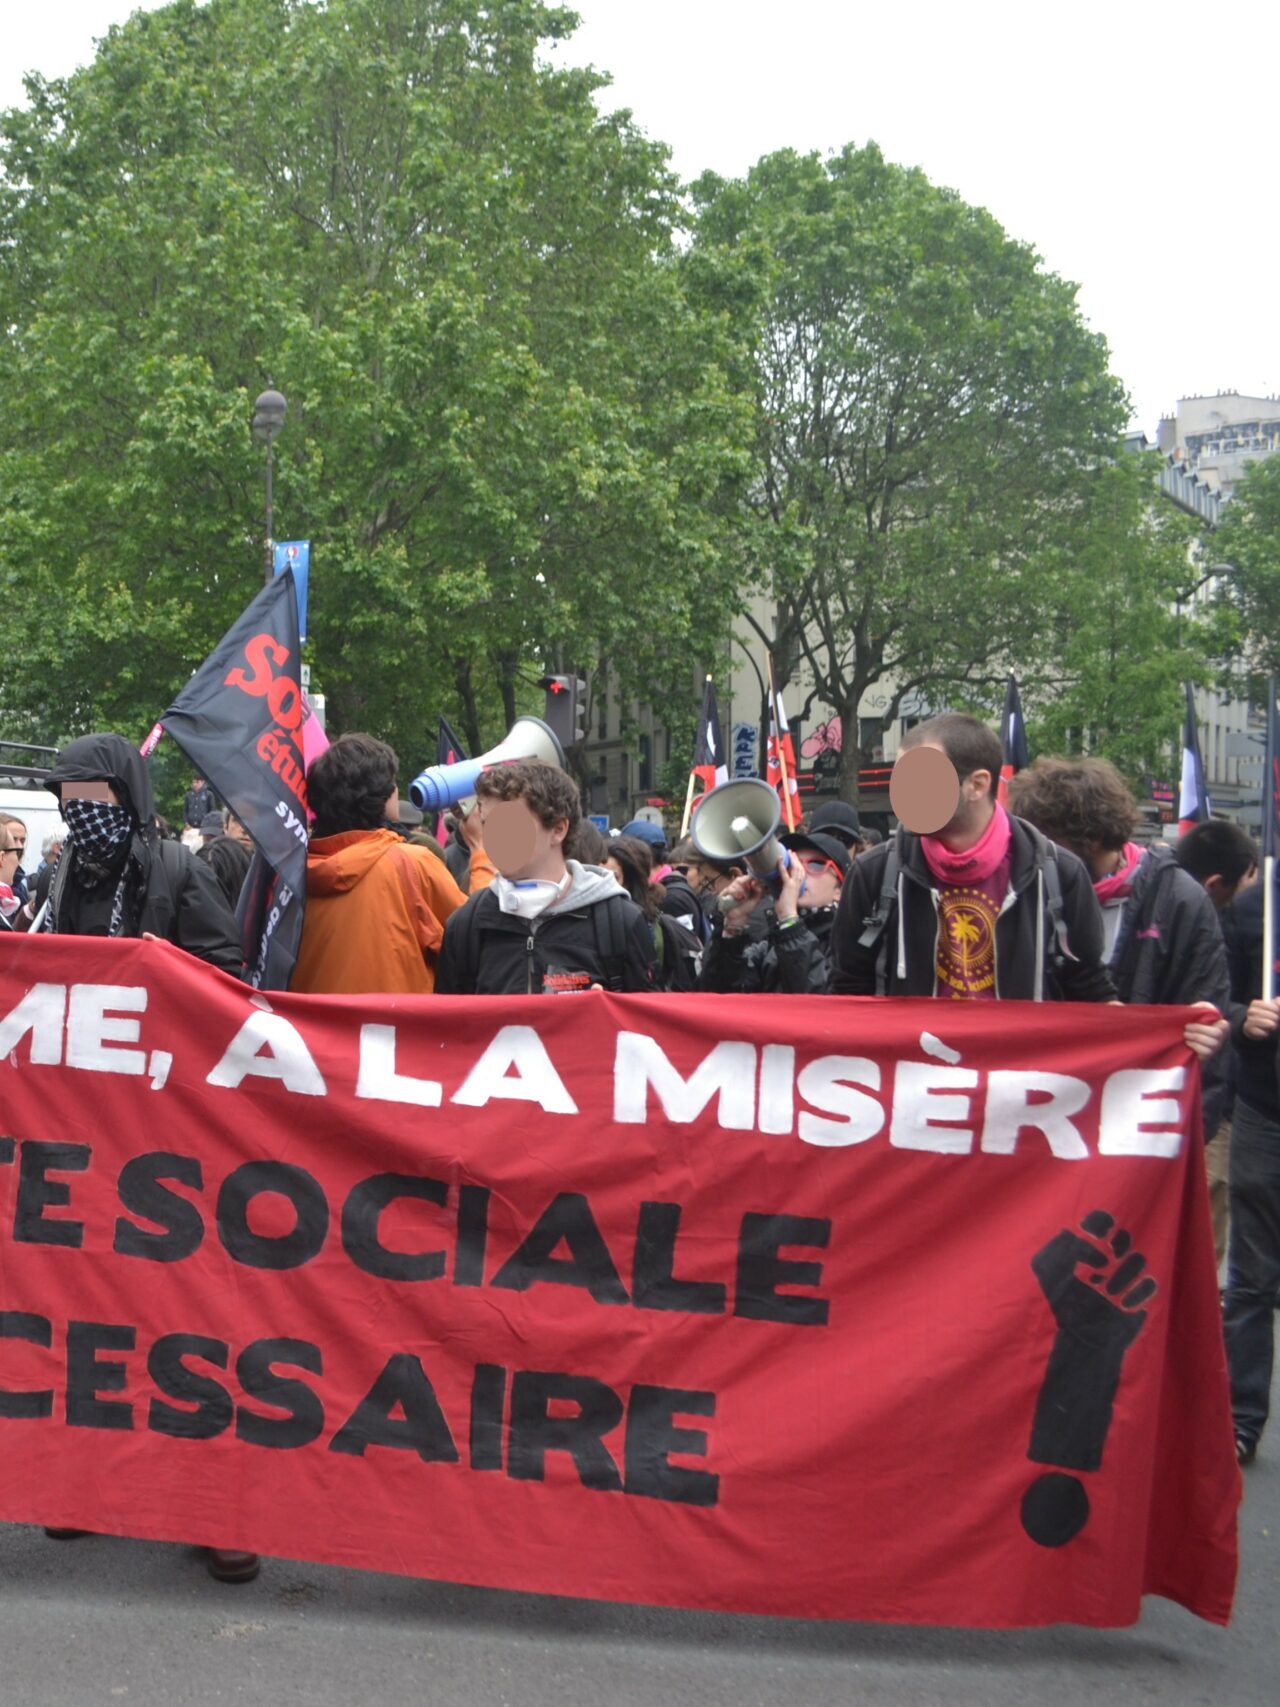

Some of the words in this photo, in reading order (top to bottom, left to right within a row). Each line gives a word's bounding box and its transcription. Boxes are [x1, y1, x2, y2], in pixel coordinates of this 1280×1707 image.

[355, 1023, 580, 1115] LA
[613, 1029, 1187, 1161] MISÈRE
[113, 1151, 832, 1326] SOCIALE
